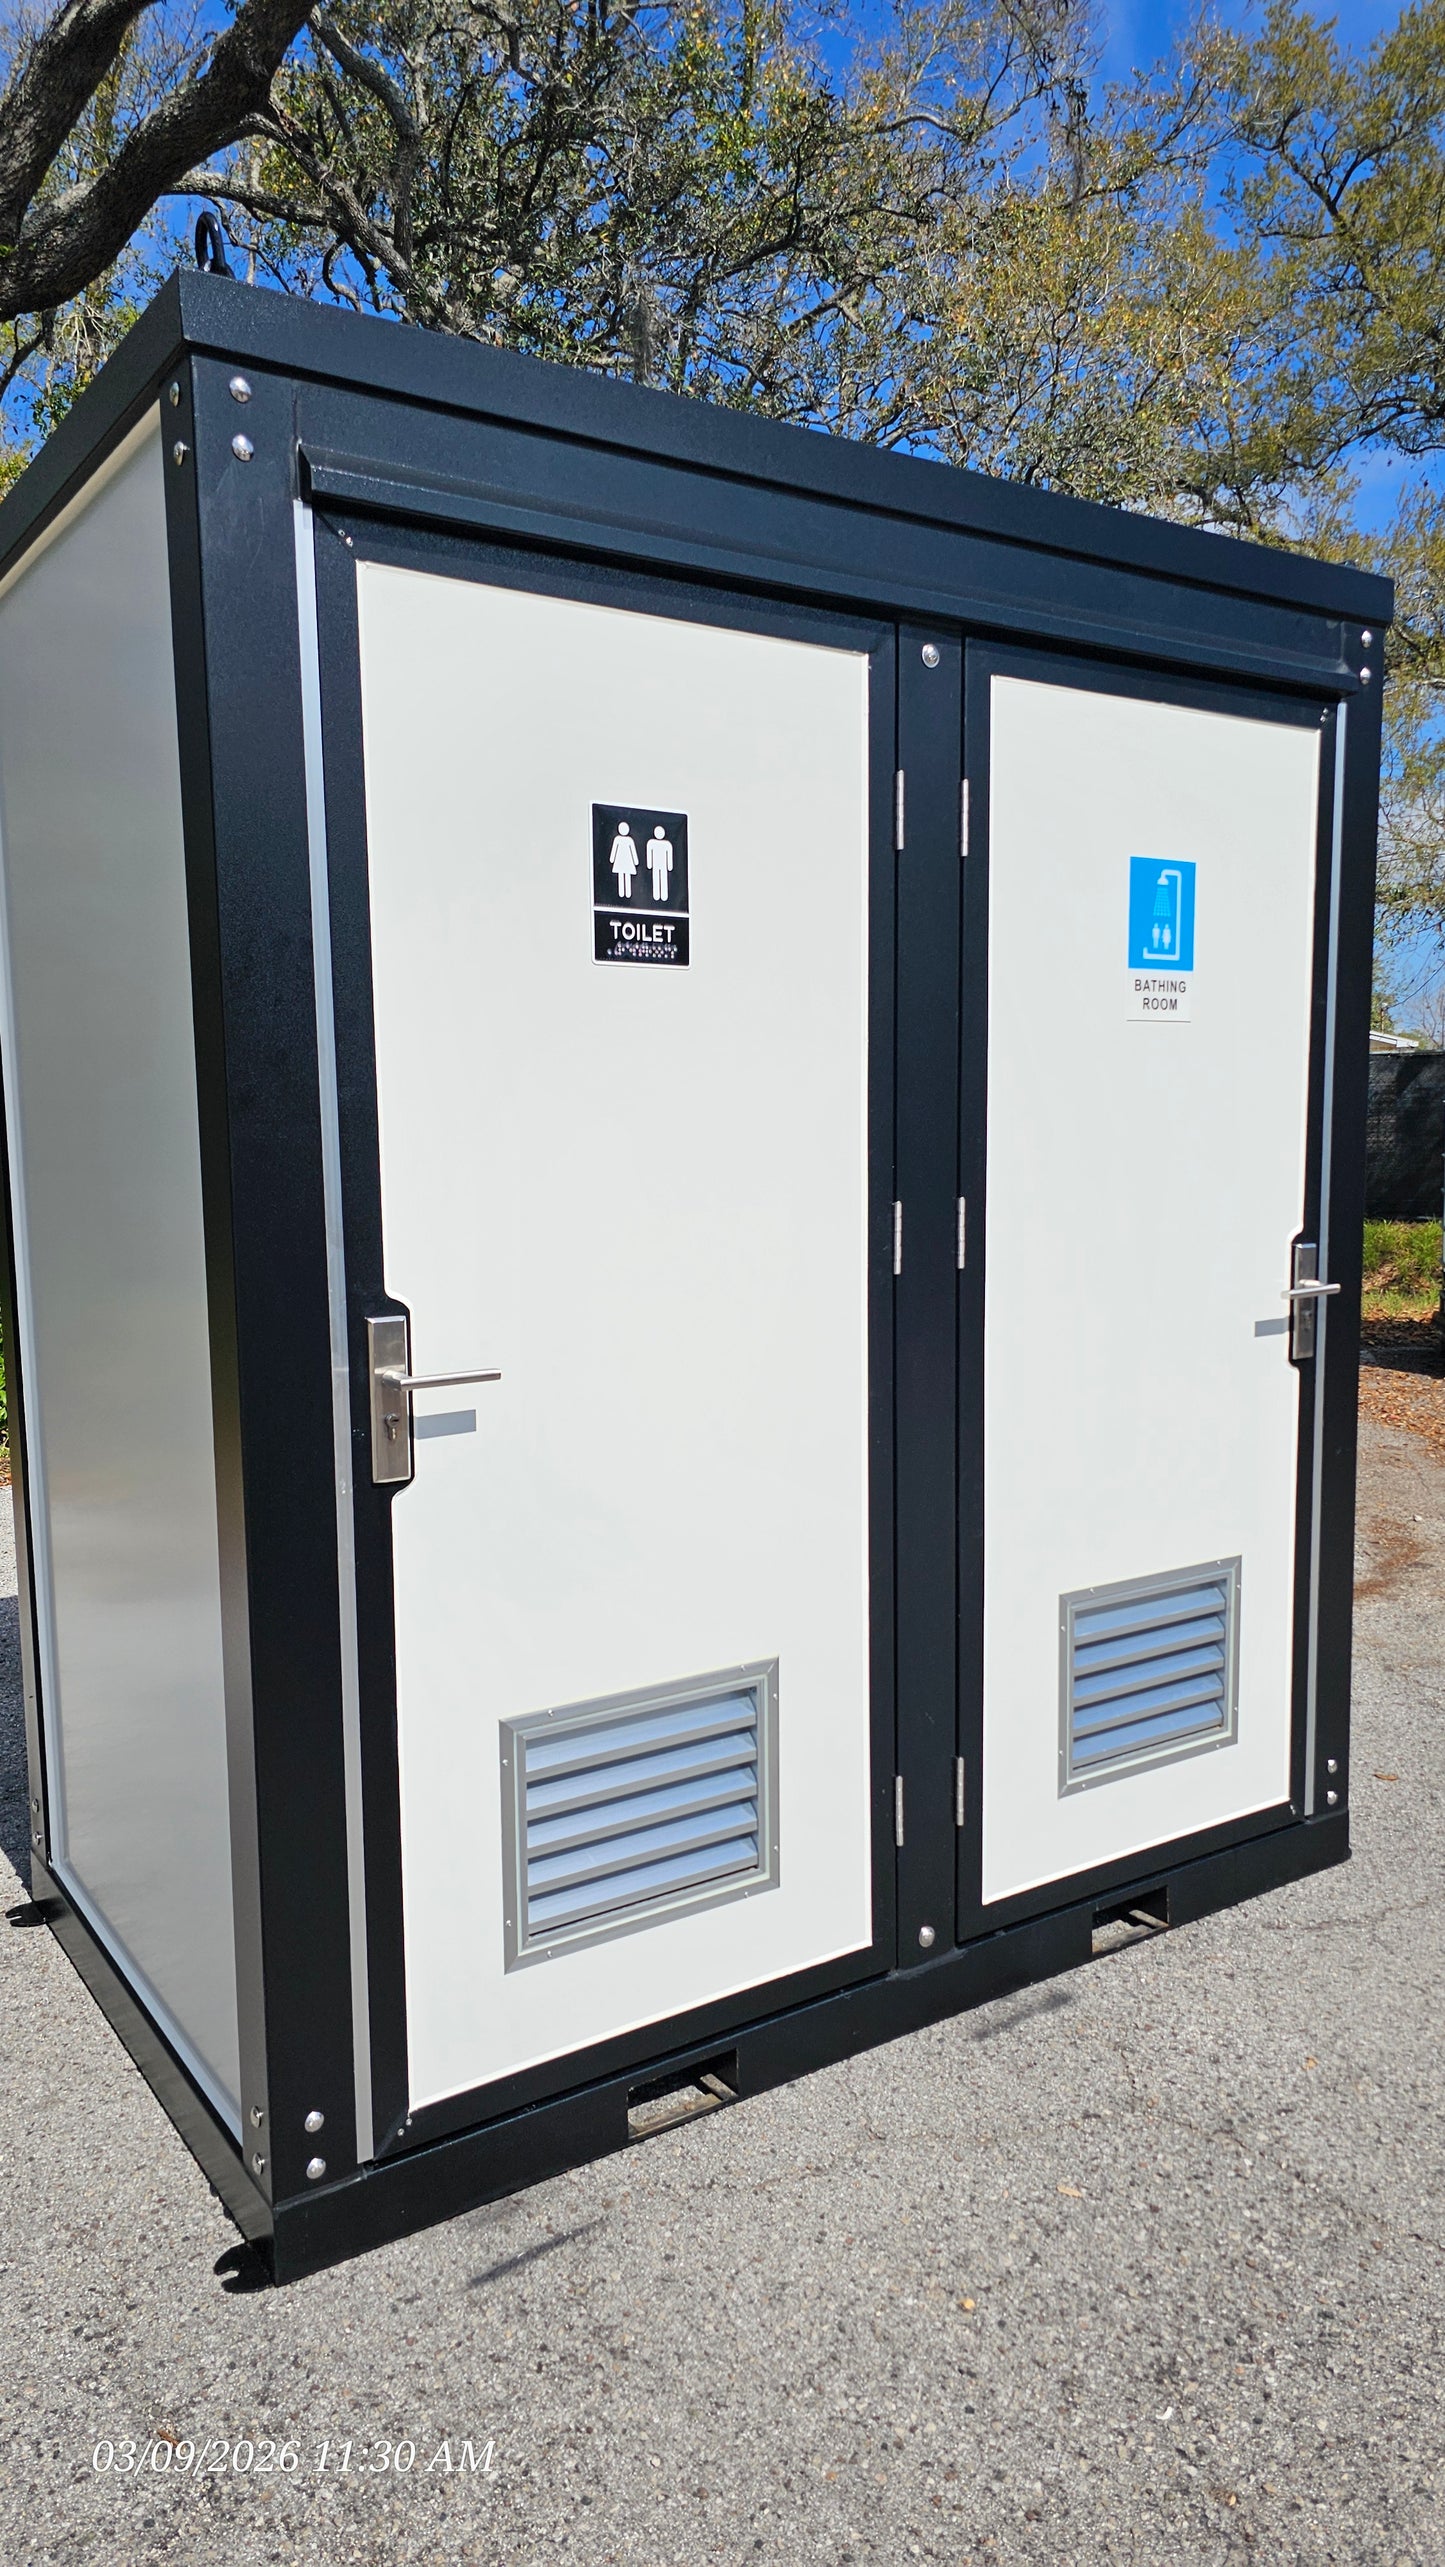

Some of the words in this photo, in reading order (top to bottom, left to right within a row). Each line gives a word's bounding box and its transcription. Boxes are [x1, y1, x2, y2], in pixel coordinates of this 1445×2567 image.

[609, 920, 676, 943] TOILET
[1134, 979, 1187, 993] BATHING
[1142, 997, 1178, 1011] ROOM
